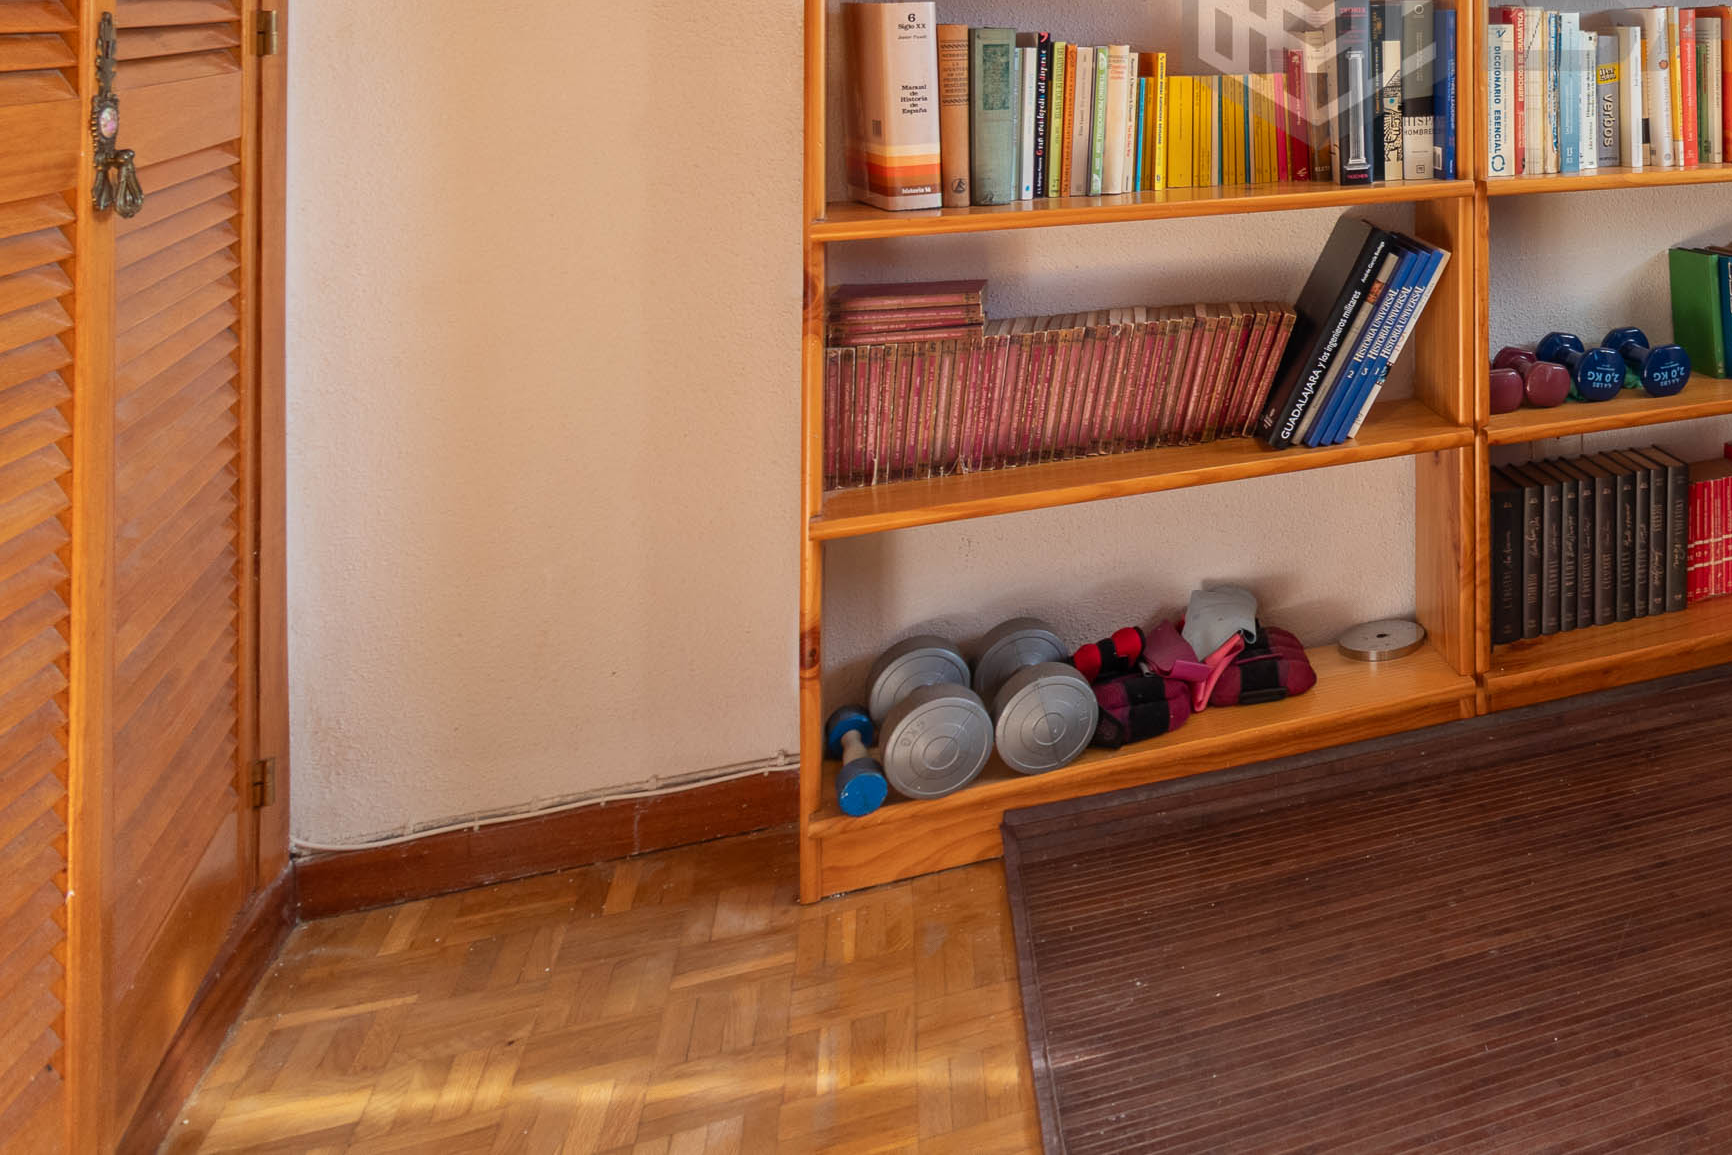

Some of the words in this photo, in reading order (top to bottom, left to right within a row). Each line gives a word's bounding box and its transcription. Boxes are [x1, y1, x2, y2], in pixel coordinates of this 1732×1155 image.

[906, 13, 916, 23] 6
[1601, 93, 1614, 147] verbos
[1353, 319, 1382, 363] HISTORIA
[1375, 287, 1399, 321] UNIVERSAL
[1367, 318, 1395, 360] HISTORIA
[1389, 286, 1413, 320] UNIVERSAL
[1380, 317, 1407, 359] HISTORIA
[1401, 285, 1426, 319] UNIVERSAL
[1281, 368, 1321, 439] GUADALAJARA
[1320, 347, 1329, 364] los
[1326, 315, 1350, 350] ingenieros
[1344, 290, 1361, 323] militares
[1587, 371, 1602, 382] KG
[1653, 371, 1668, 382] KG
